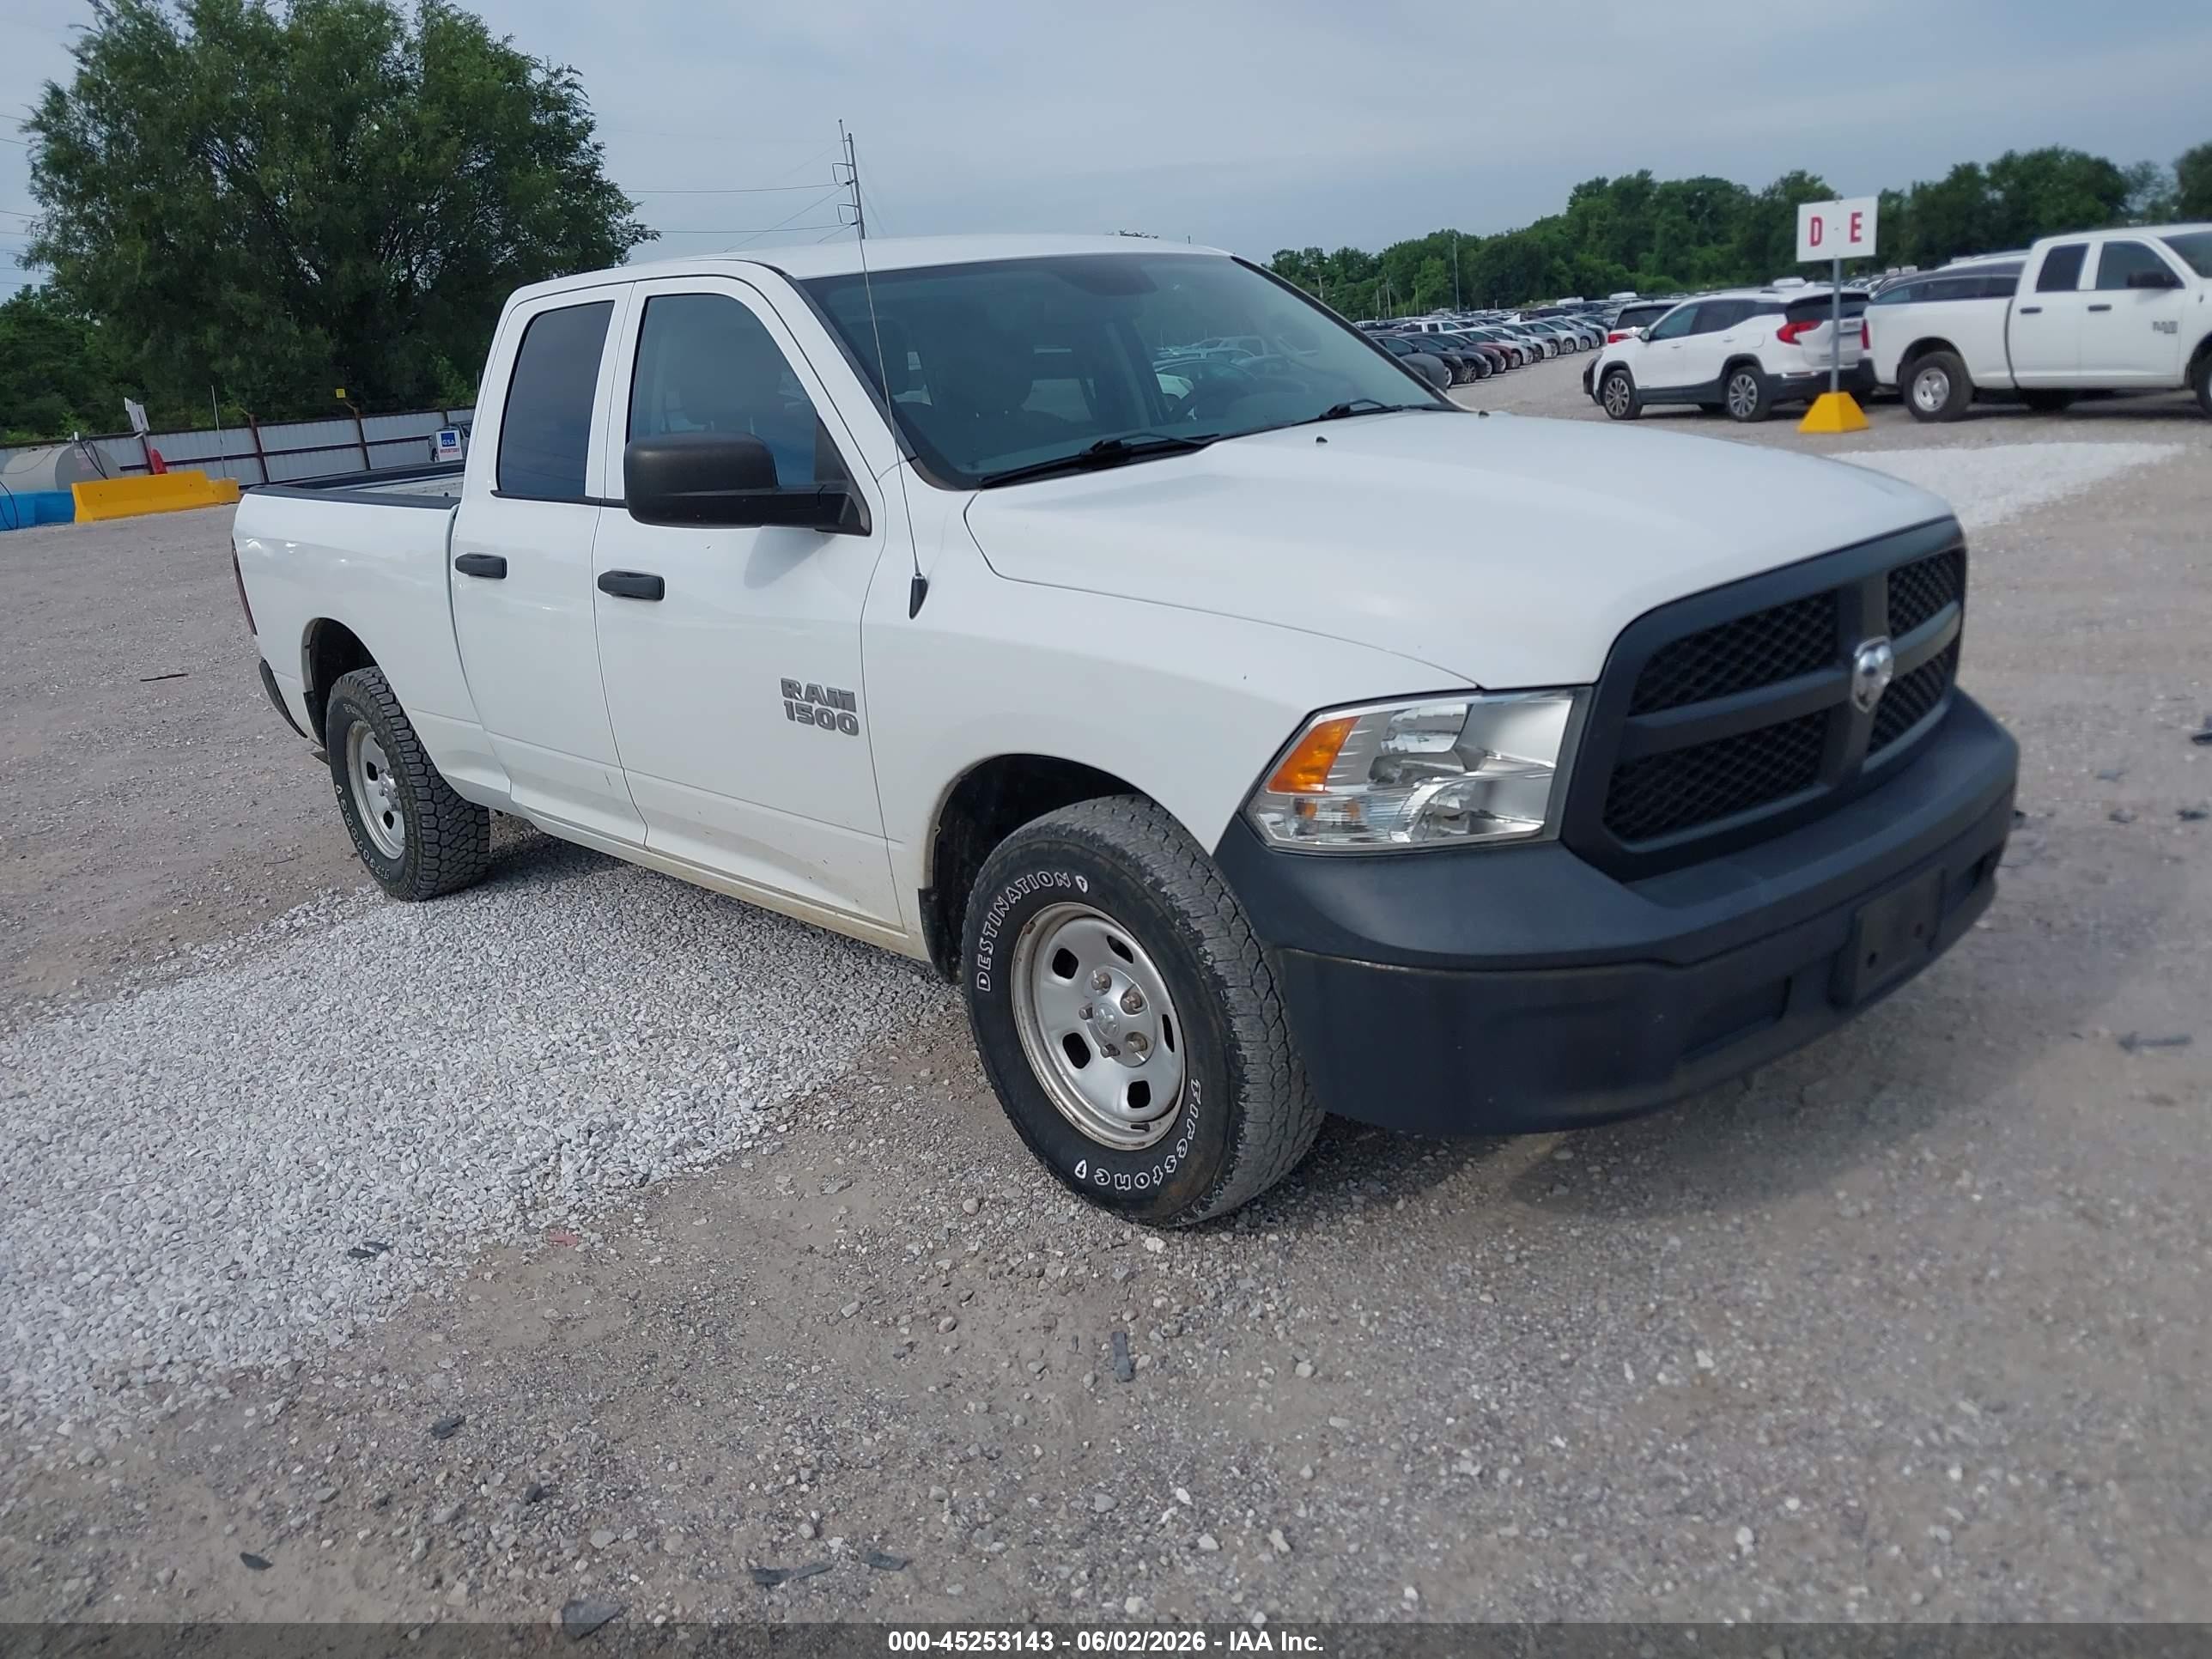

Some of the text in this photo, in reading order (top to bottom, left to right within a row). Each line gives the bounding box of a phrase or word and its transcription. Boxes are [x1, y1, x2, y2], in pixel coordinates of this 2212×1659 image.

[1809, 211, 1863, 247] D E
[781, 678, 857, 713] RAM
[783, 700, 860, 737] 1500
[976, 871, 1072, 992] DESTINATION
